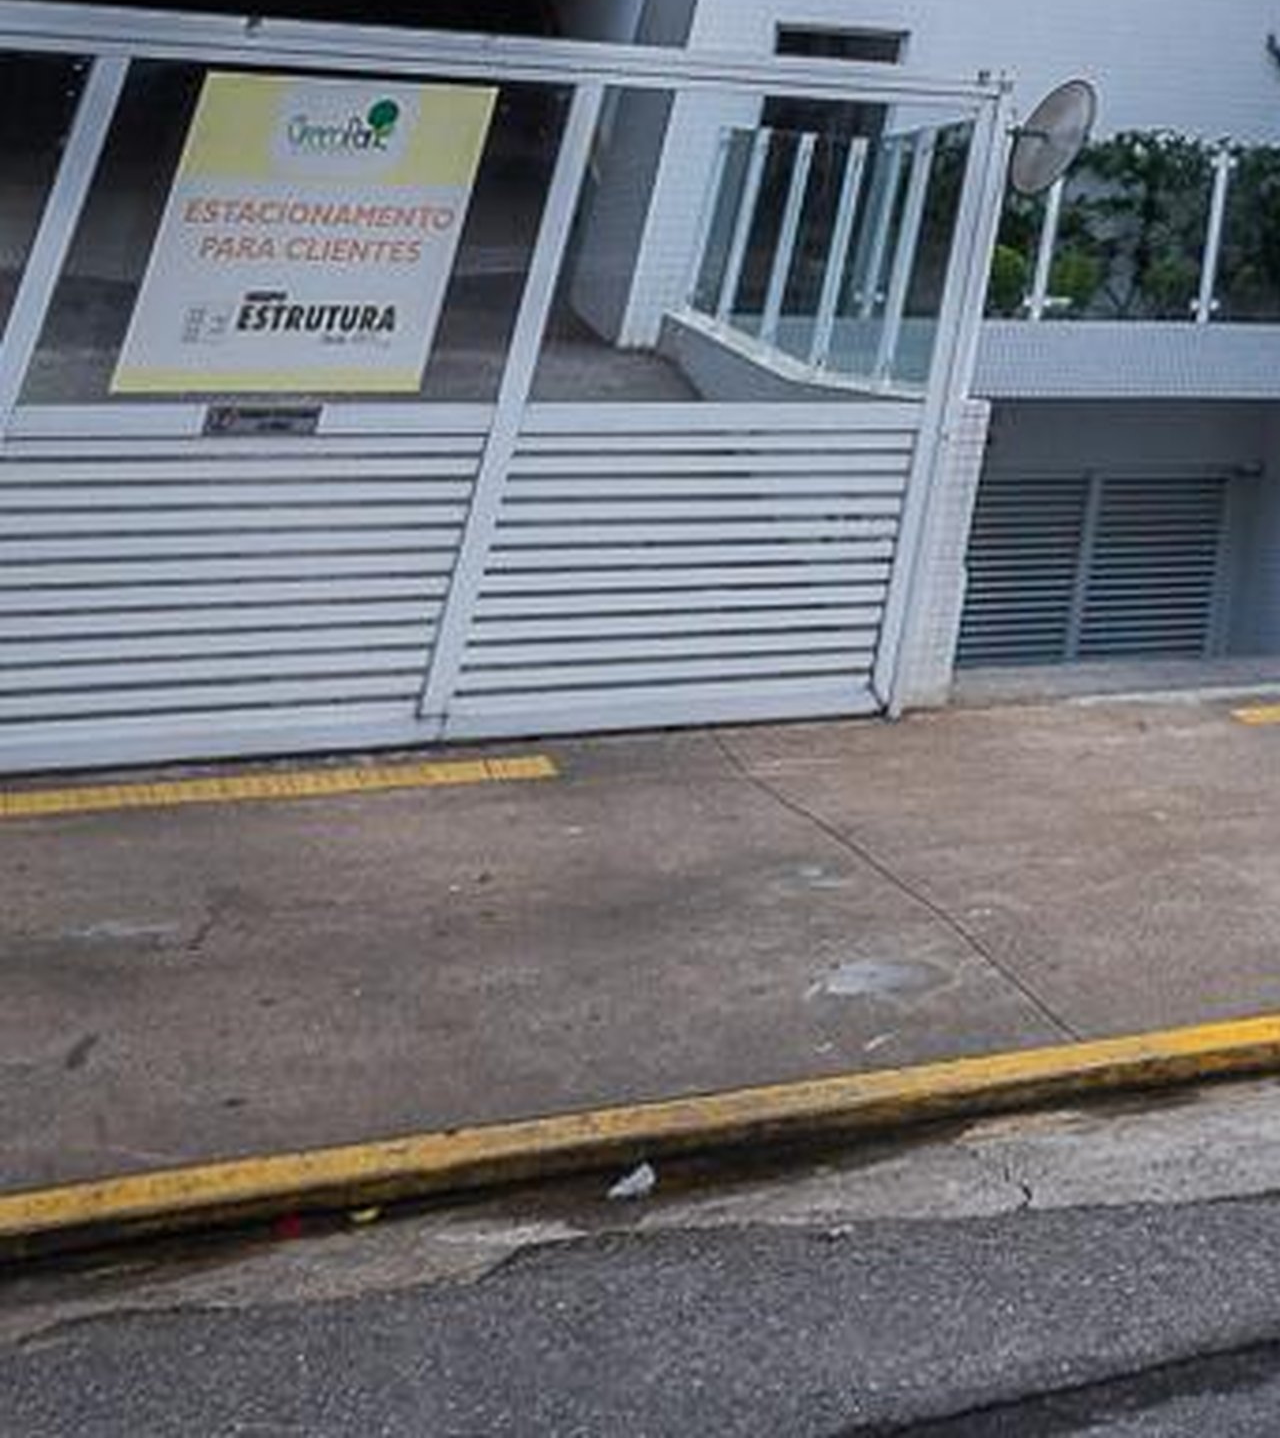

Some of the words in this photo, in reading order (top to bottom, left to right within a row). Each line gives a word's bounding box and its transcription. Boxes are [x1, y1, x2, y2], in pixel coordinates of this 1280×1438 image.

[183, 197, 455, 231] ESTACIONAMENTO
[200, 236, 277, 261] PARA
[286, 237, 422, 263] CLIENTES
[236, 304, 396, 332] ESTRUTURA
